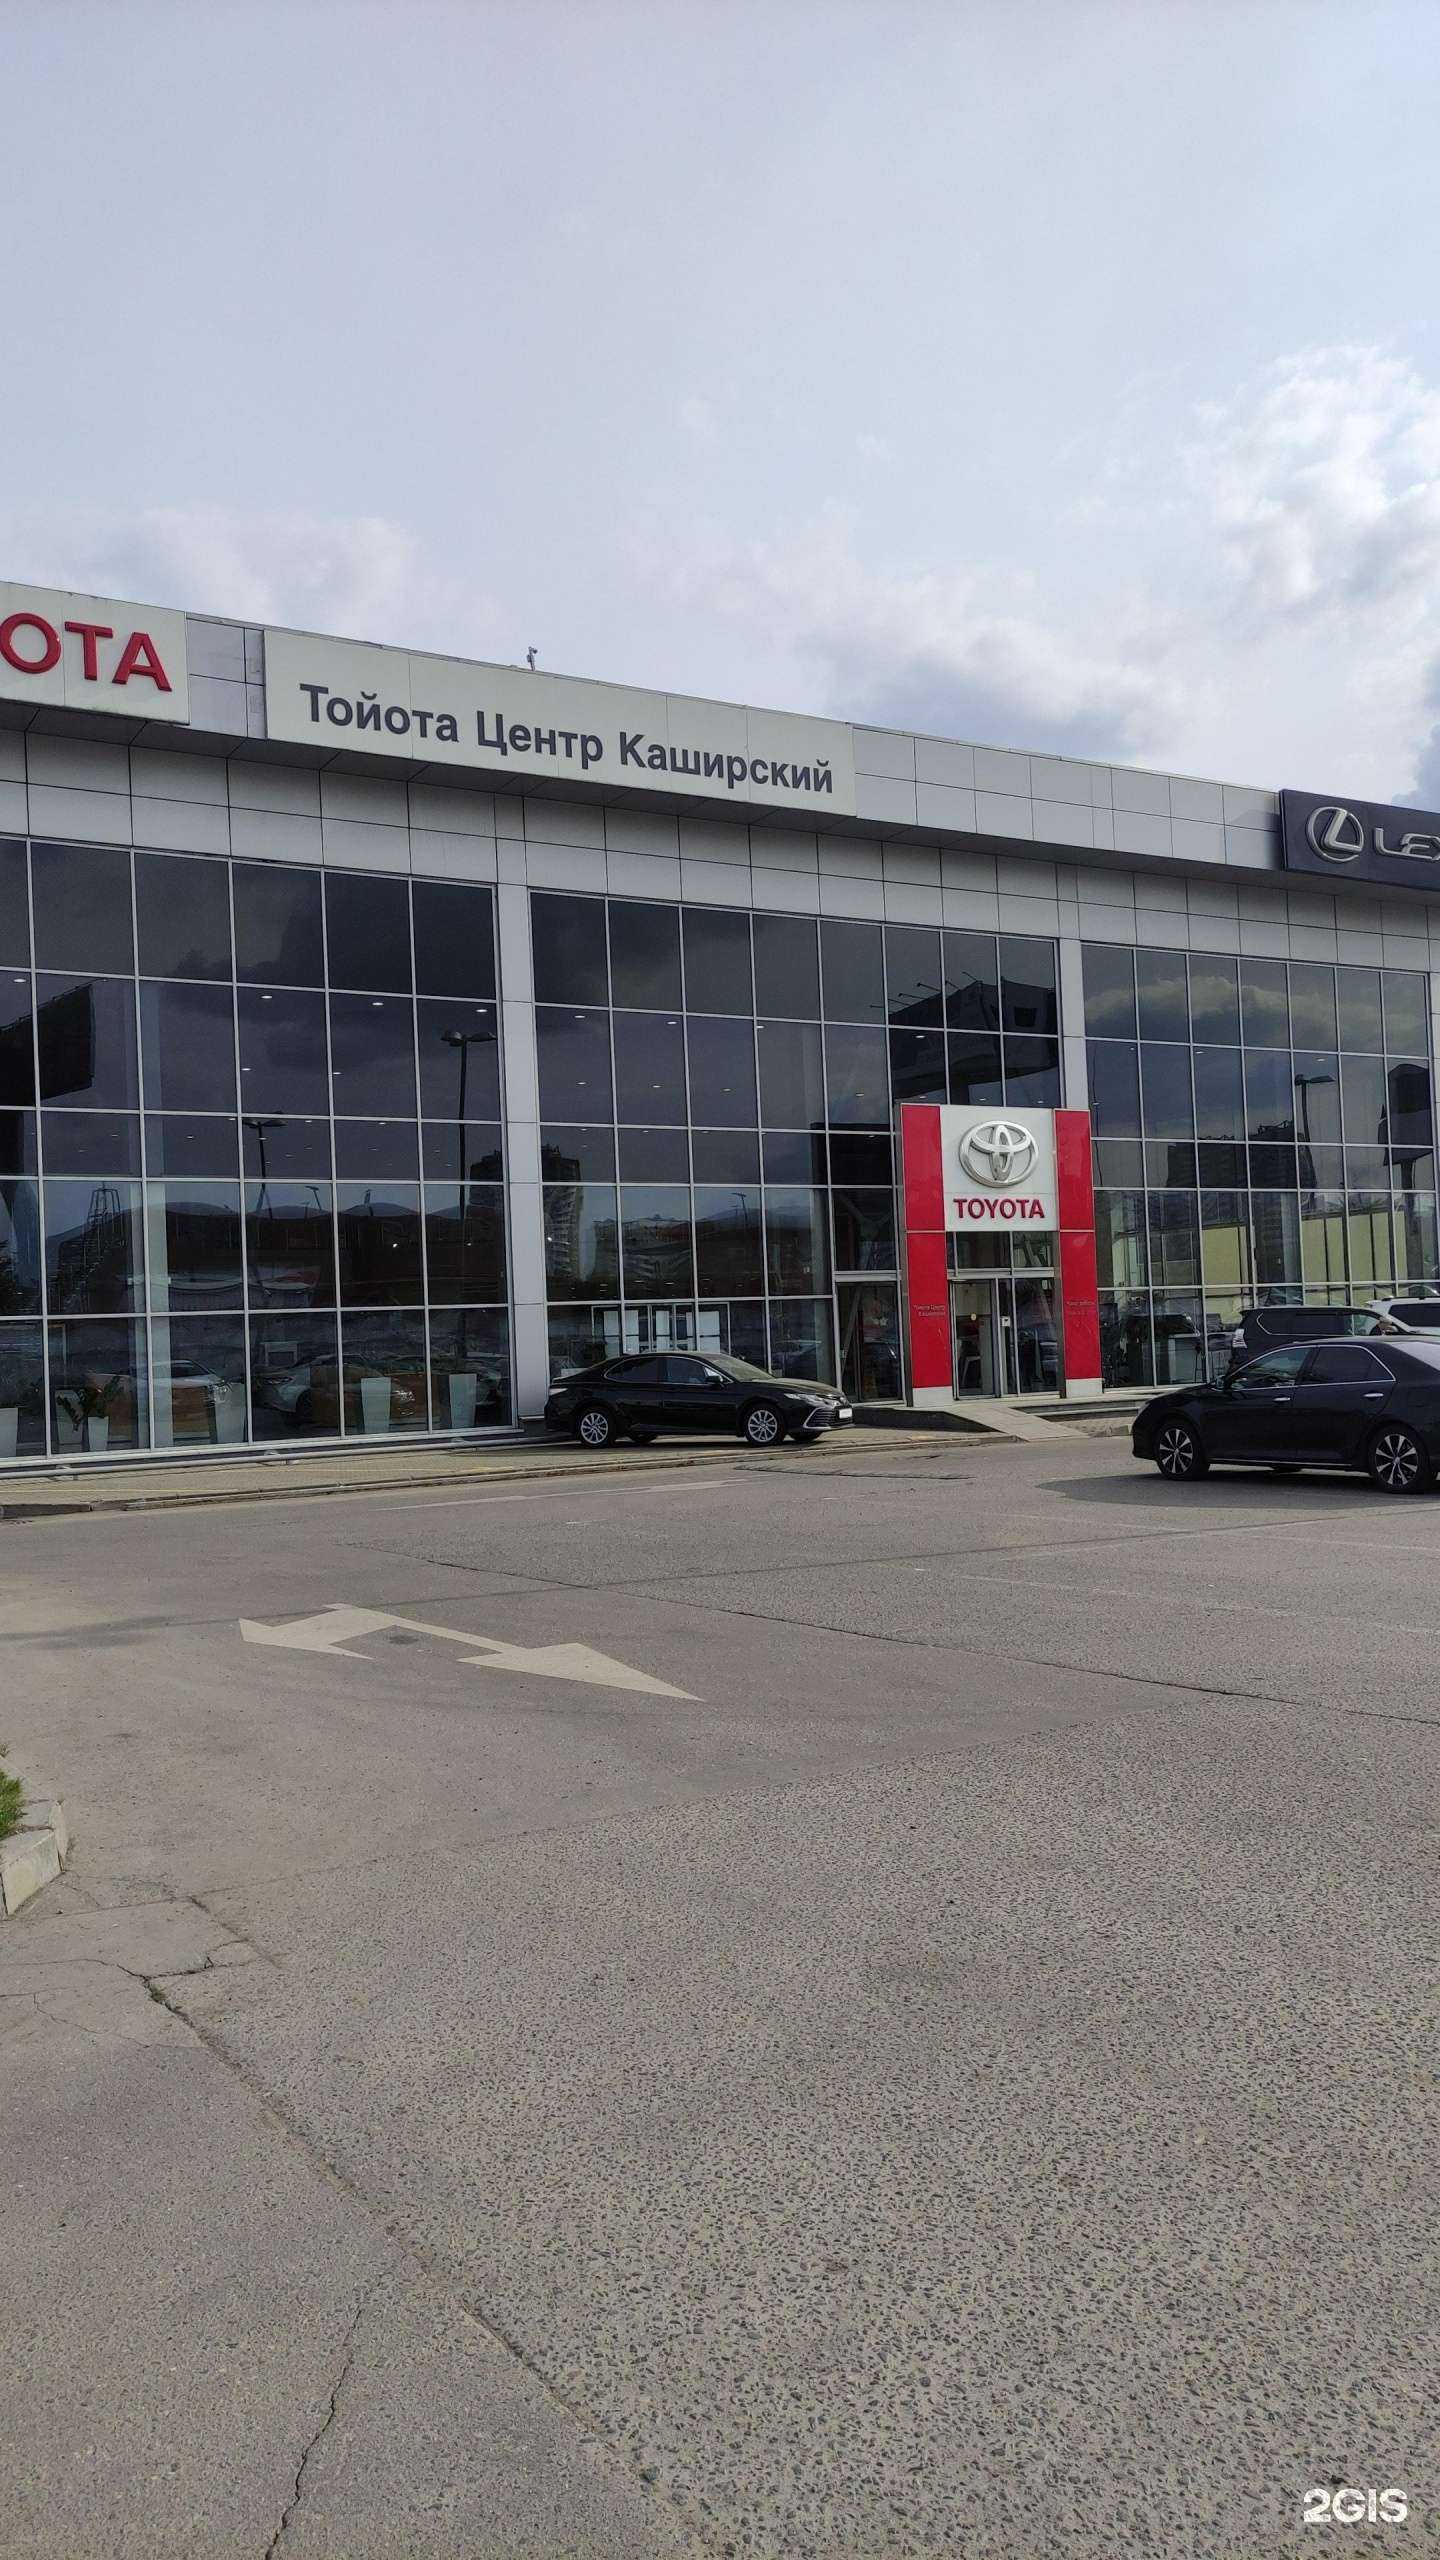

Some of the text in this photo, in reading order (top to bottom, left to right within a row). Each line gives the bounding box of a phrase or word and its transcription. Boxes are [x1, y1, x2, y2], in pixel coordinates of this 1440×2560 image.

[299, 683, 833, 793] Тойота Центр Каширский
[1375, 827, 1440, 860] LE
[953, 1198, 1045, 1219] TOYOTA
